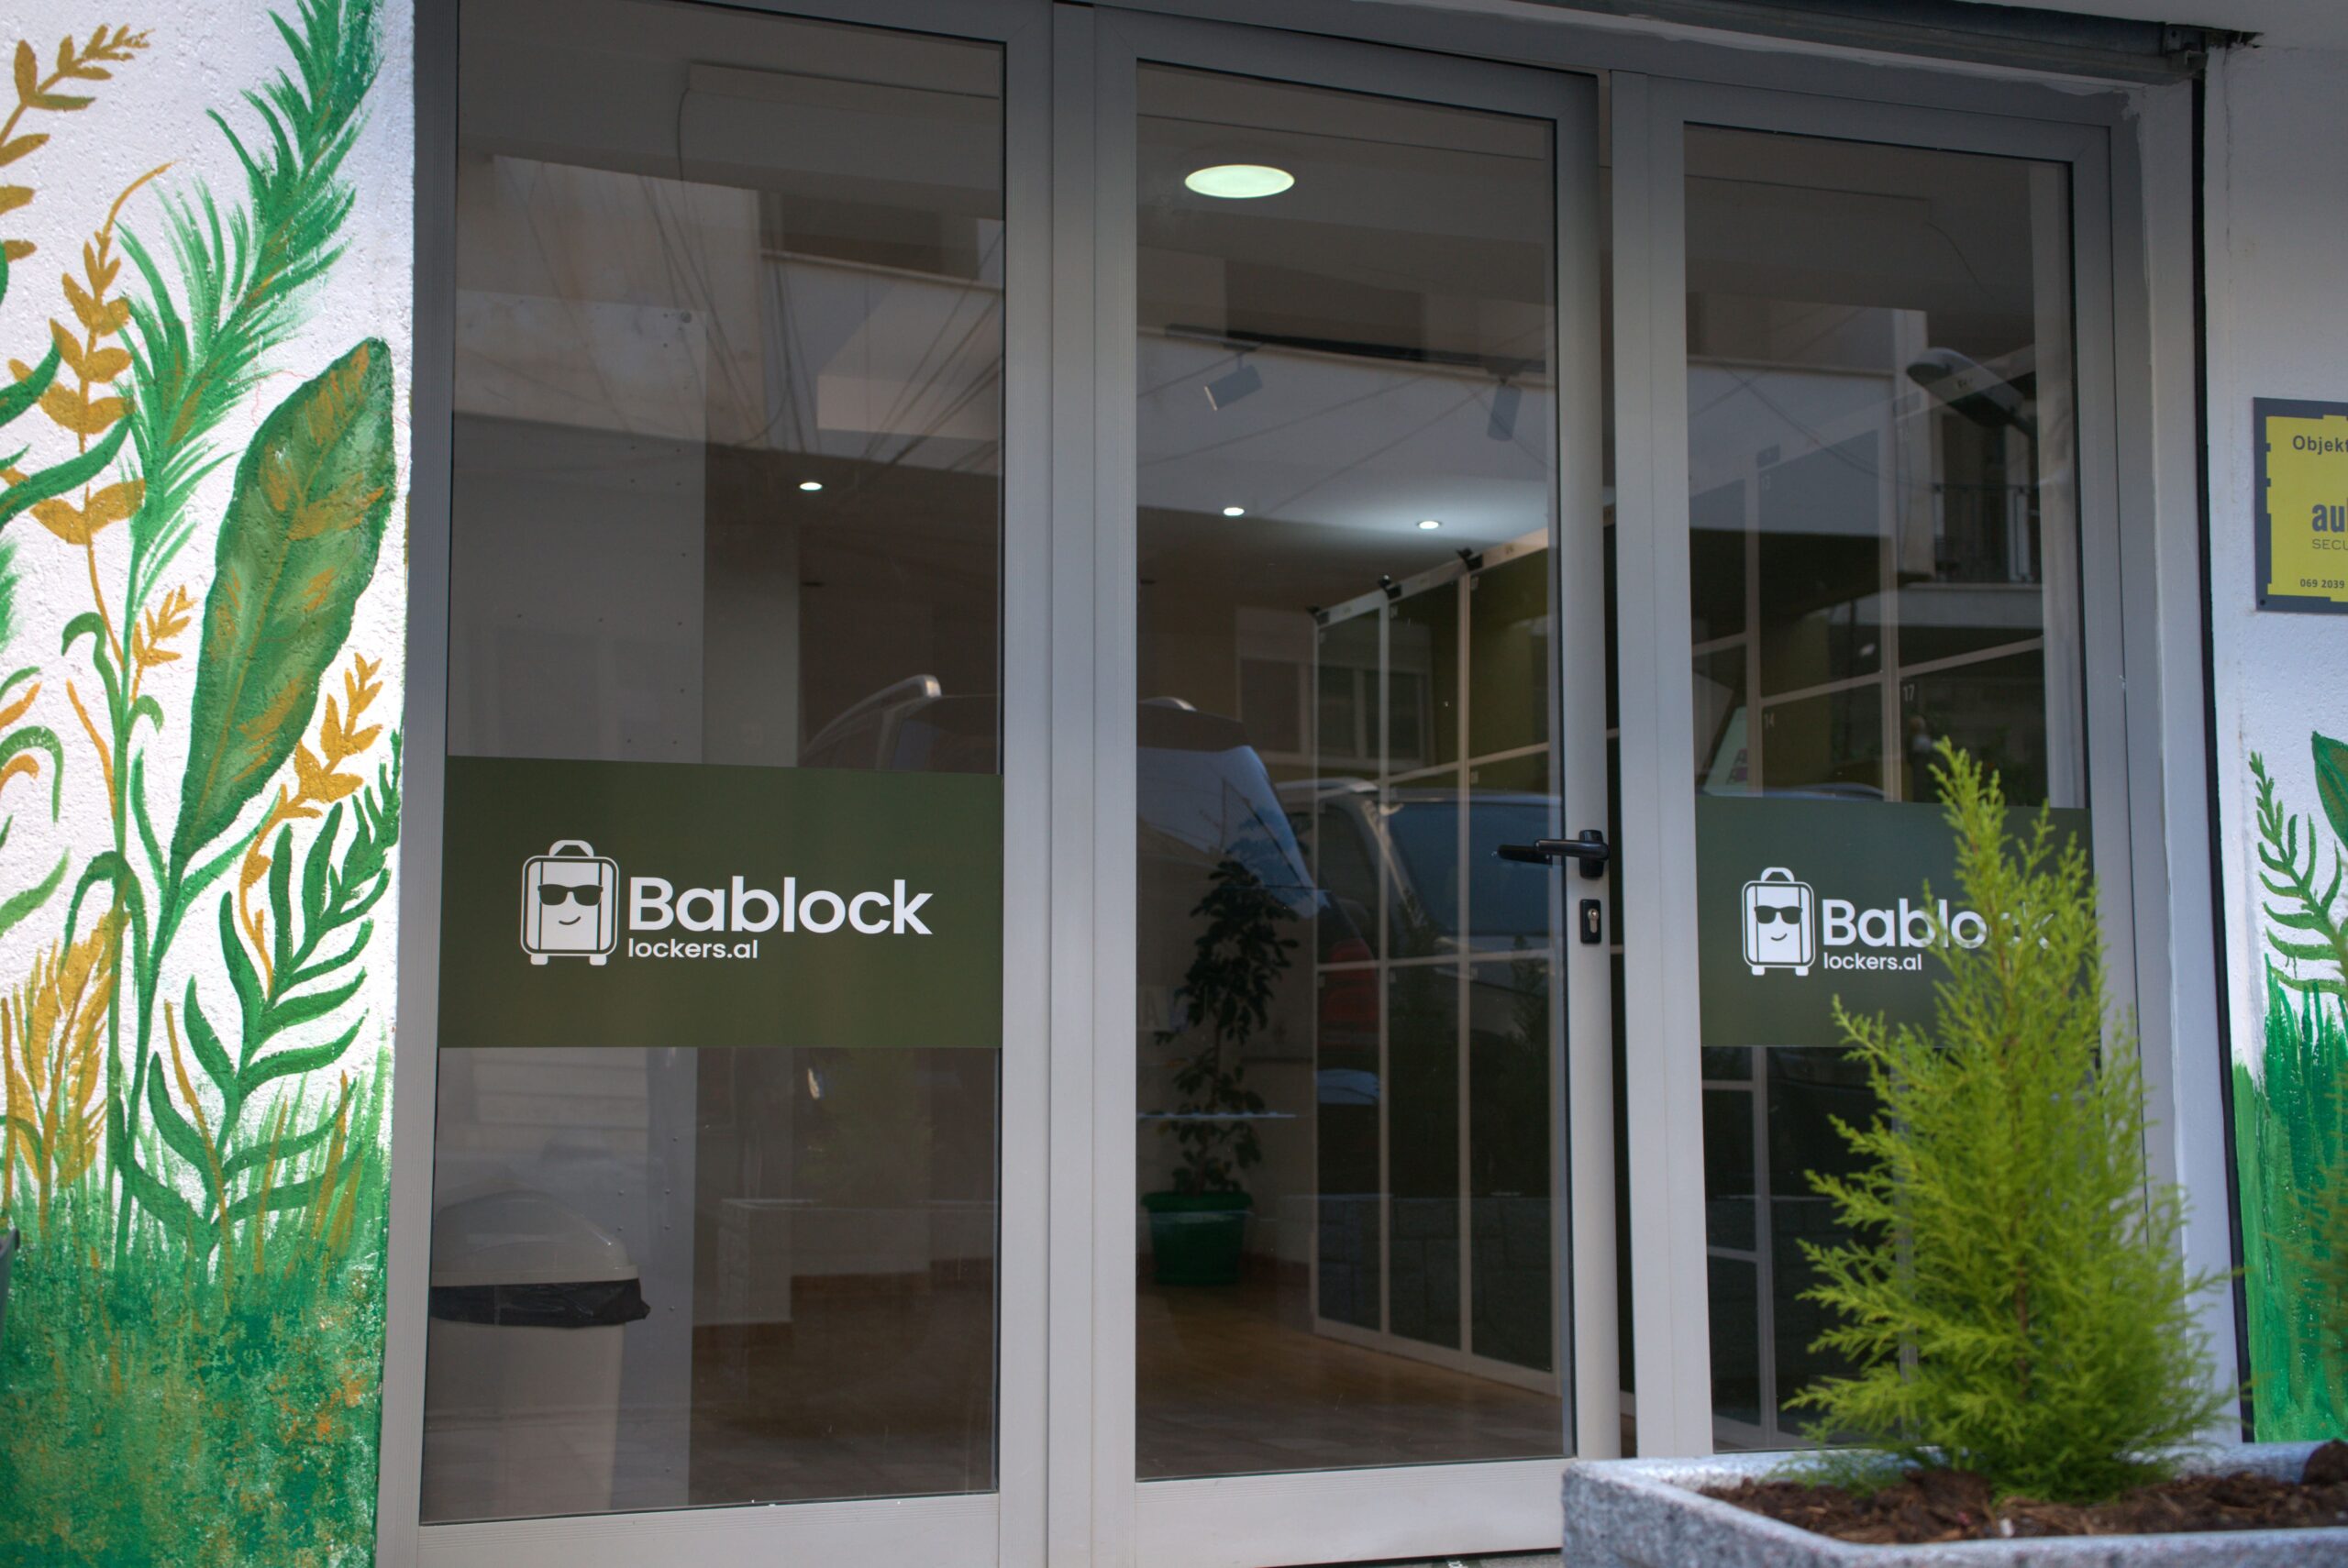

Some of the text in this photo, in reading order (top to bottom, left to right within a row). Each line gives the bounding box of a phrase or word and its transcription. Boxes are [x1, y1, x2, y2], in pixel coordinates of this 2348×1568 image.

[2299, 578, 2345, 589] 069 2039
[628, 875, 934, 935] Bablock
[1822, 898, 2054, 949] Bablo
[628, 937, 759, 959] lockers.al
[1823, 952, 1922, 971] lockers.al
